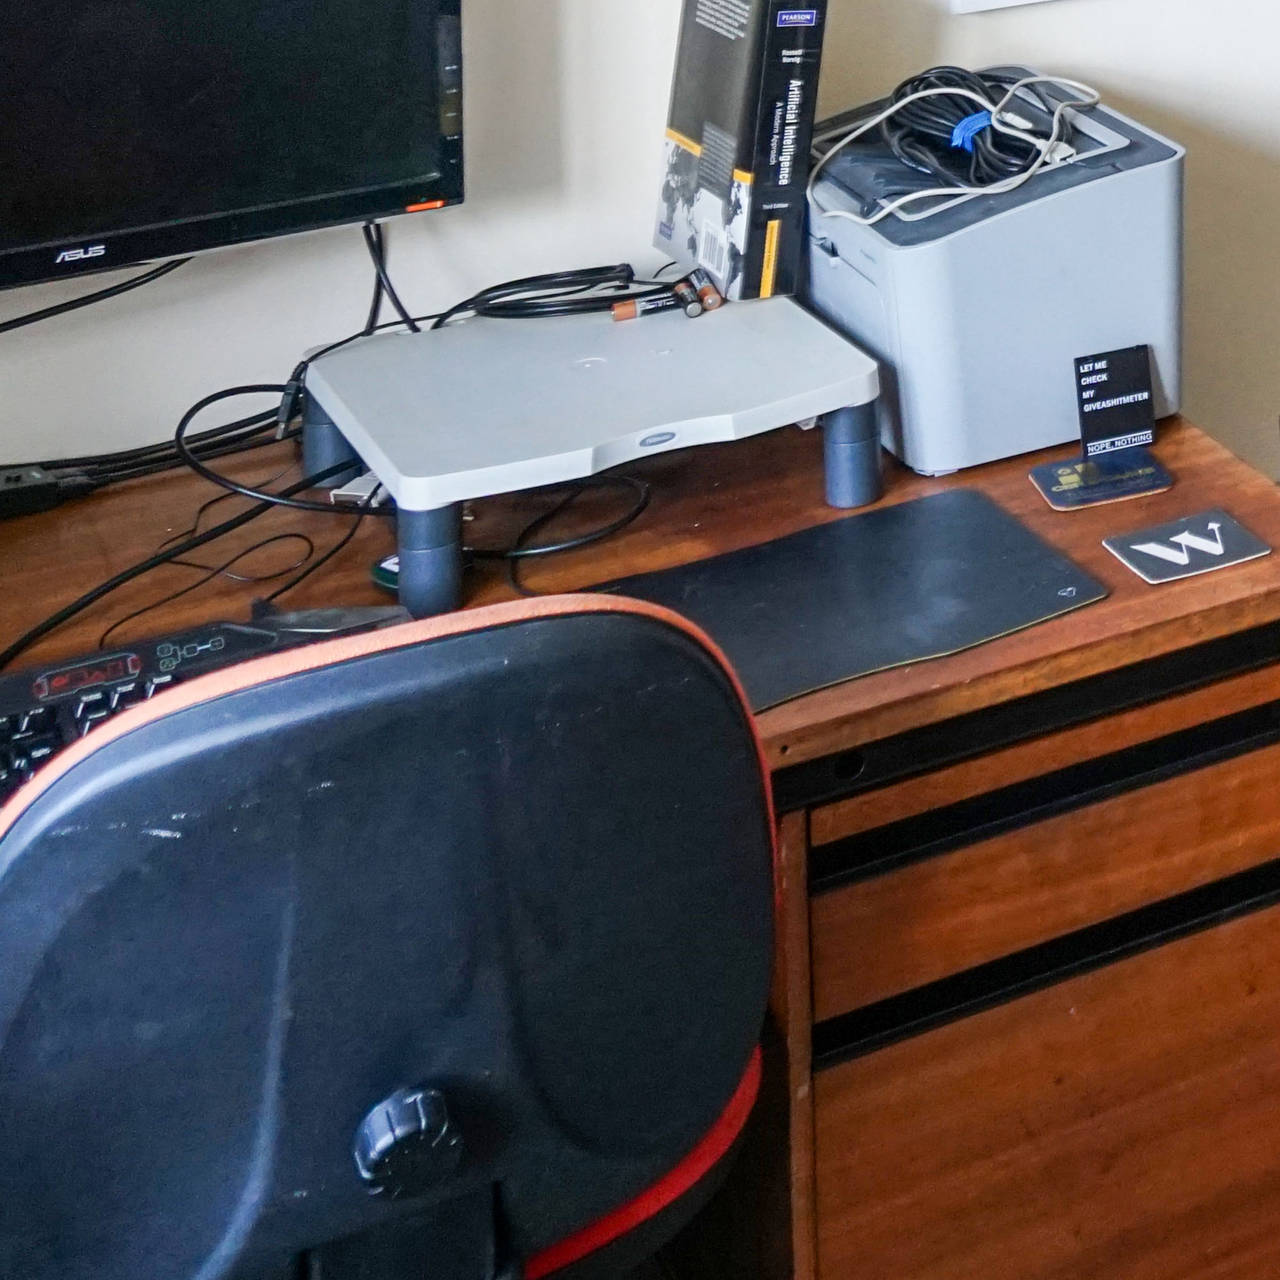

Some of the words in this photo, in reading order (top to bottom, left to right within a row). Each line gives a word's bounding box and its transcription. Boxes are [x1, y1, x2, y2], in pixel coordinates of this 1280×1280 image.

[781, 13, 812, 25] PEARSON
[785, 80, 803, 126] Artificial
[773, 111, 783, 137] Modern
[770, 136, 781, 167] Approach
[778, 127, 800, 187] Intelligence
[55, 245, 106, 264] ASUS
[1080, 363, 1095, 374] LET
[1094, 360, 1108, 372] ME
[1081, 373, 1108, 386] CHECK
[1082, 389, 1096, 400] MY
[1083, 391, 1150, 413] GIVEASHITMETER
[1087, 441, 1115, 455] NOPE,
[1114, 432, 1153, 450] NOTHING
[1129, 521, 1225, 566] W
